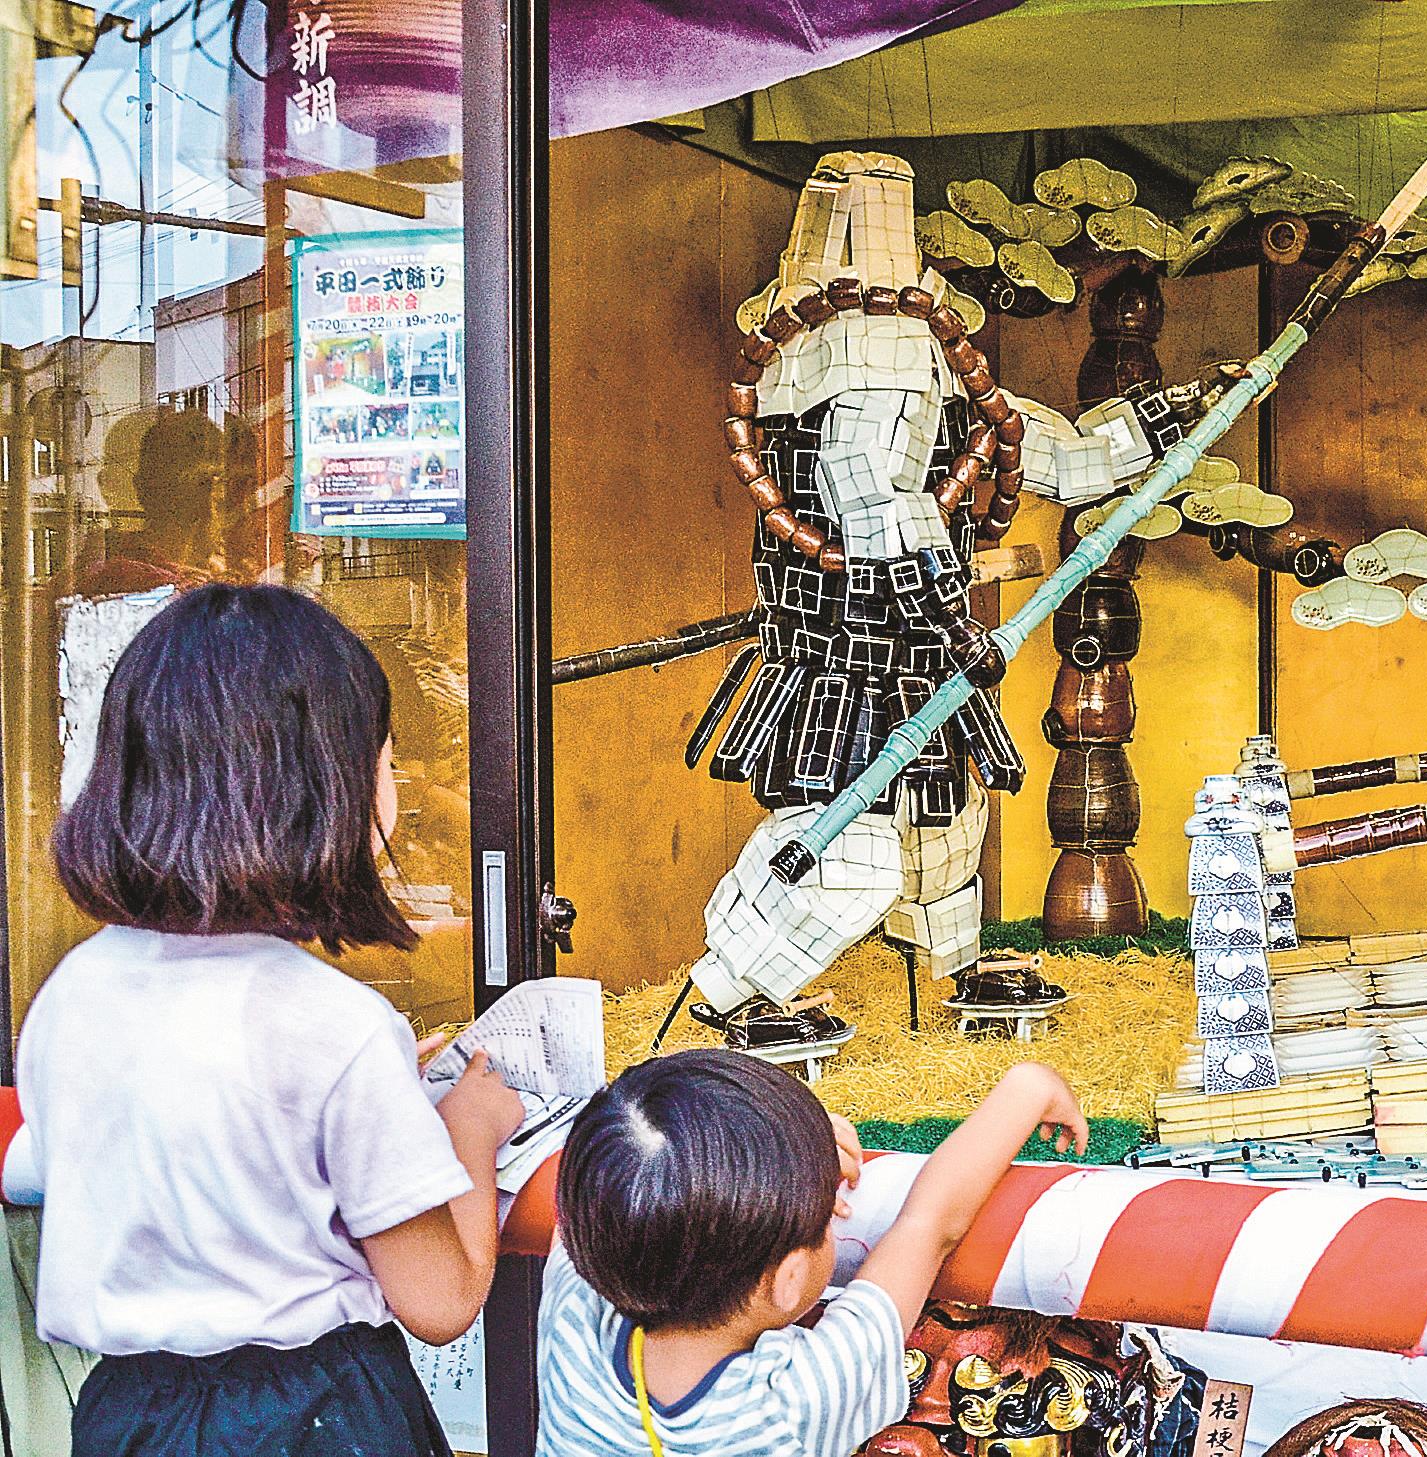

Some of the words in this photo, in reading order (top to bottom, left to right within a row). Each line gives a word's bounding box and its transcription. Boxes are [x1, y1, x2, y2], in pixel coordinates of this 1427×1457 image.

[290, 0, 337, 135] 新調
[315, 266, 445, 296] 平田一式飾り
[1205, 1391, 1241, 1457] 桔梗
